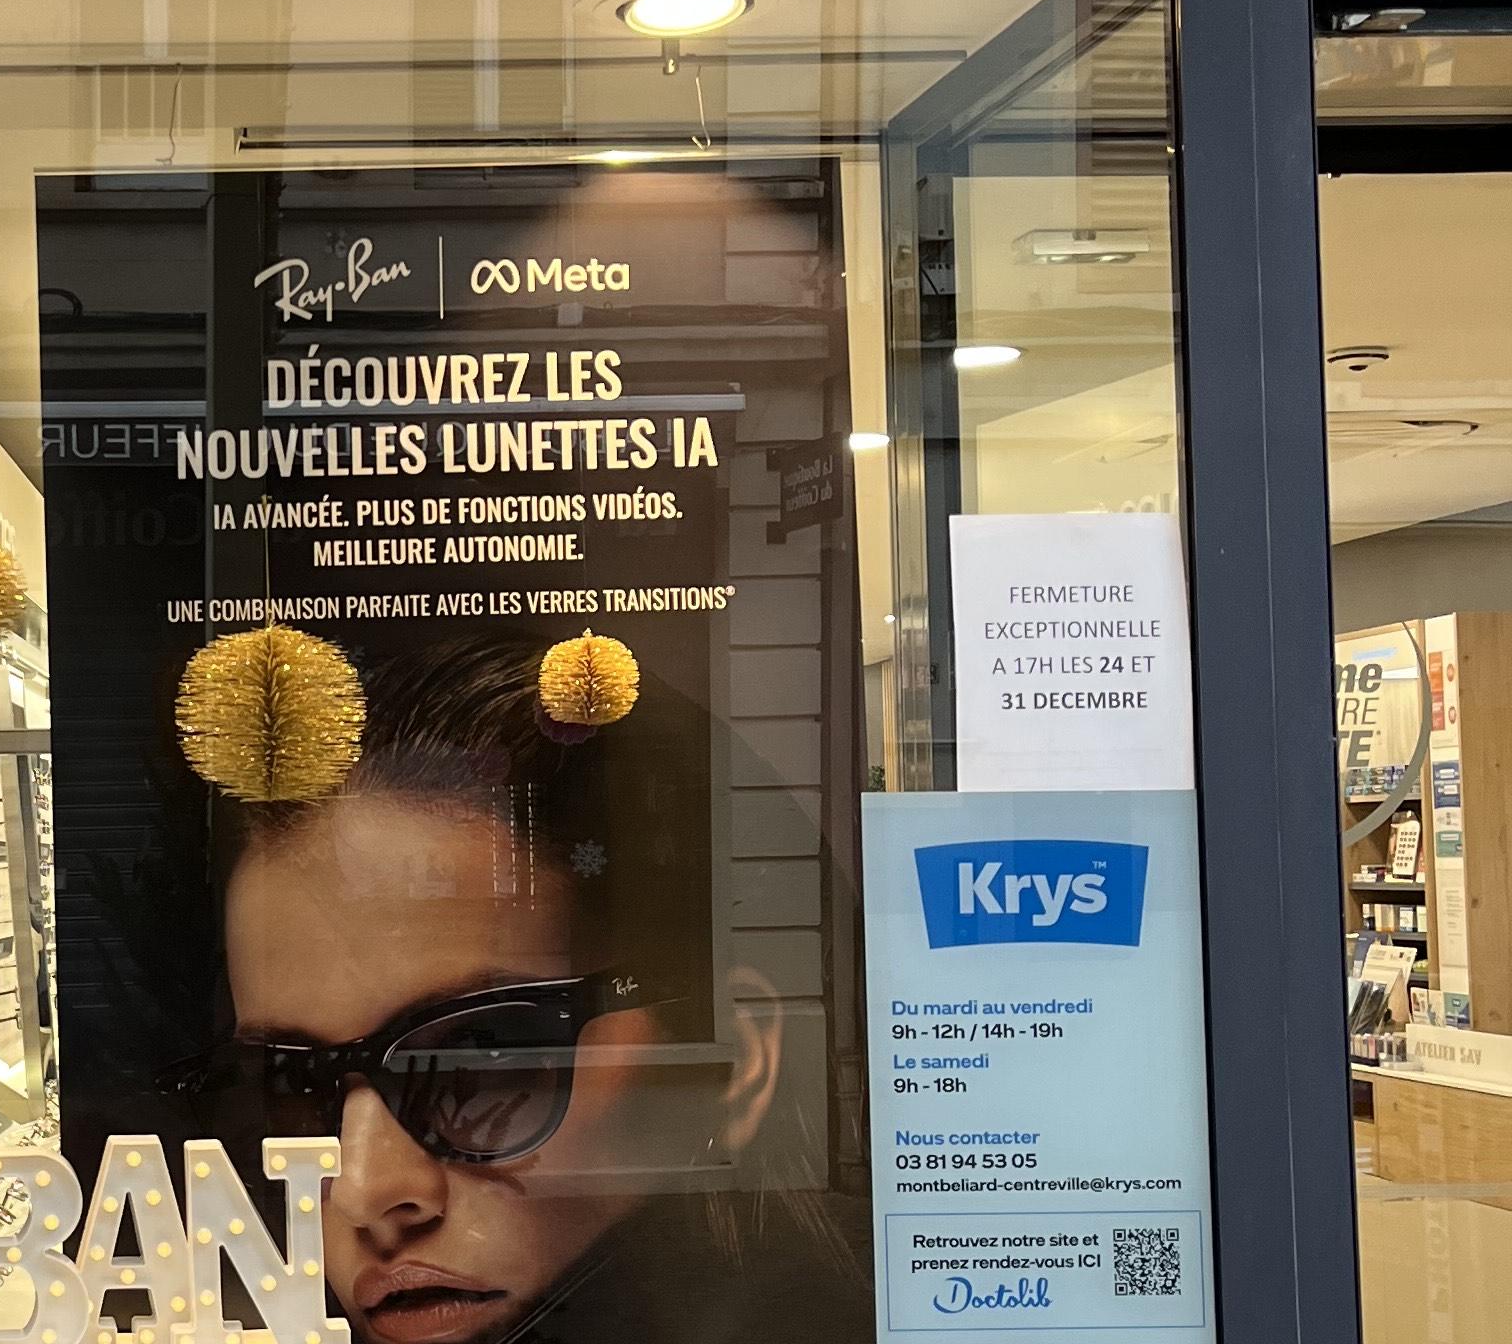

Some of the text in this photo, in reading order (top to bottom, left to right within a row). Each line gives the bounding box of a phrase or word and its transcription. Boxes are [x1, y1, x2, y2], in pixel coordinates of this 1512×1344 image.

[253, 237, 630, 323] Ray-Ban Meta
[267, 345, 623, 411] DÉCOUVREZ LES
[176, 417, 719, 481] NOUVELLES LUNETTES IA
[213, 499, 237, 531] IA
[242, 493, 350, 530] AVANCÉE.
[356, 497, 415, 528] PLUS
[421, 497, 453, 526] DE
[457, 492, 587, 525] FONCTIONS
[593, 487, 684, 522] VIDÉOS.
[312, 534, 585, 568] MEILLEURE AUTONOMIE.
[1009, 584, 1134, 604] FERMETURE
[167, 599, 204, 624] UNE
[209, 596, 341, 623] COMBINAISON
[345, 593, 430, 620] PARFAITE
[436, 592, 484, 618] AVEC
[488, 590, 522, 617] LES
[526, 587, 598, 615] VERRES
[984, 619, 1162, 640] EXCEPTIONNELLE
[992, 655, 1156, 675] A 17H LES 24 ET
[1000, 691, 1149, 710] 31 DECEMBRE
[958, 861, 1108, 927] Krys
[891, 998, 1094, 1016] Du mardi au vendredi
[891, 1023, 917, 1040] 9h
[932, 1023, 965, 1040] 12h
[981, 1023, 1015, 1039] 14h
[1030, 1022, 1063, 1039] 19h
[1414, 1041, 1456, 1061] ATELIER
[893, 1053, 990, 1070] Le samedi
[893, 1077, 968, 1094] 9h 18h
[895, 1130, 1041, 1146] Nous contacter
[895, 1153, 1038, 1170] 03 81 94 53 05
[896, 1176, 1182, 1194] montbeliard-centreville@krys.com
[913, 1233, 1100, 1248] Retrouvez notre site et
[911, 1254, 1101, 1273] prenez rendez-vous ICI
[932, 1276, 1053, 1314] Doctolib
